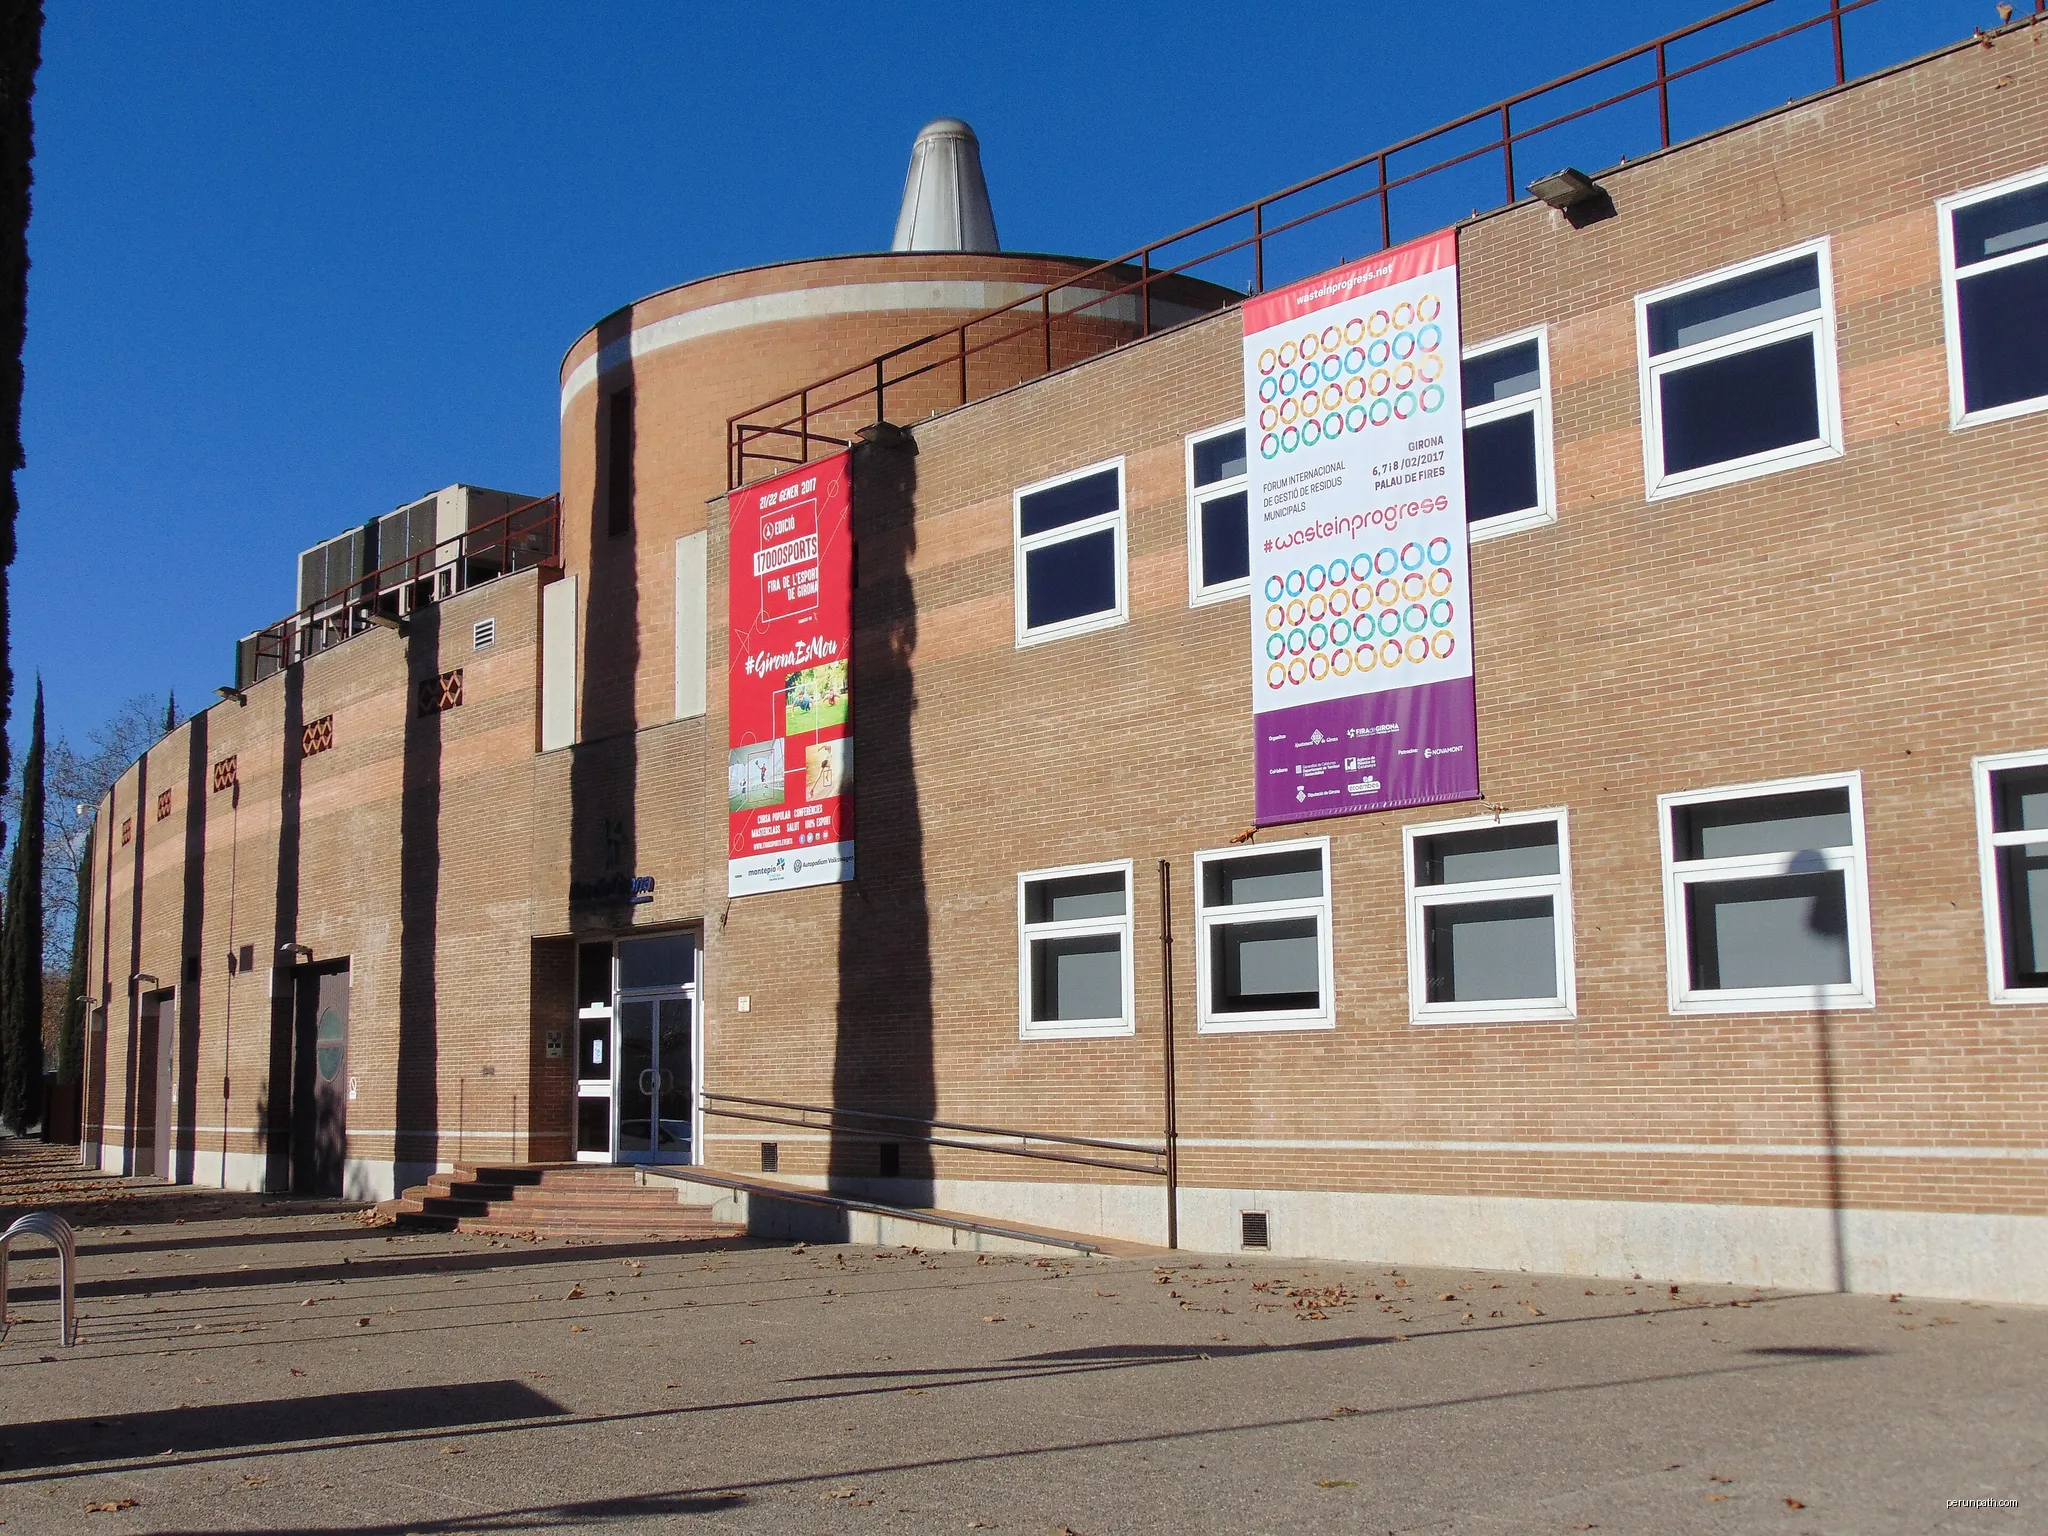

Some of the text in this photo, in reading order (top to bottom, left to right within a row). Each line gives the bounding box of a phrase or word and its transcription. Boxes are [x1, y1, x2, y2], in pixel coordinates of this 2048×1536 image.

[1296, 264, 1393, 305] wasteinprogress.net
[1408, 435, 1444, 451] GIRONA
[1263, 461, 1346, 493] FÒRUM INTERNACIONAL
[1375, 466, 1446, 491] PALAU DE FIRES
[760, 477, 817, 510] 21/22 GENER 2017
[1263, 476, 1343, 508] DE GESTIÓ DE RESIDUS
[774, 513, 796, 536] EDICIÓ
[1263, 501, 1306, 522] MUNICIPALS
[1263, 495, 1449, 553] #wasteinprogress
[757, 536, 818, 573] 17000SPORTS
[767, 566, 818, 594] FIRA DE L'ESPORT
[787, 580, 818, 601] DE GIRONA
[745, 634, 838, 679] #GironaEsMou
[1432, 745, 1464, 756] NOVAMONT
[751, 824, 781, 839] MASTERCLASS
[786, 821, 800, 833] SALUT
[757, 813, 771, 825] CURSA
[772, 809, 791, 822] POPULAR
